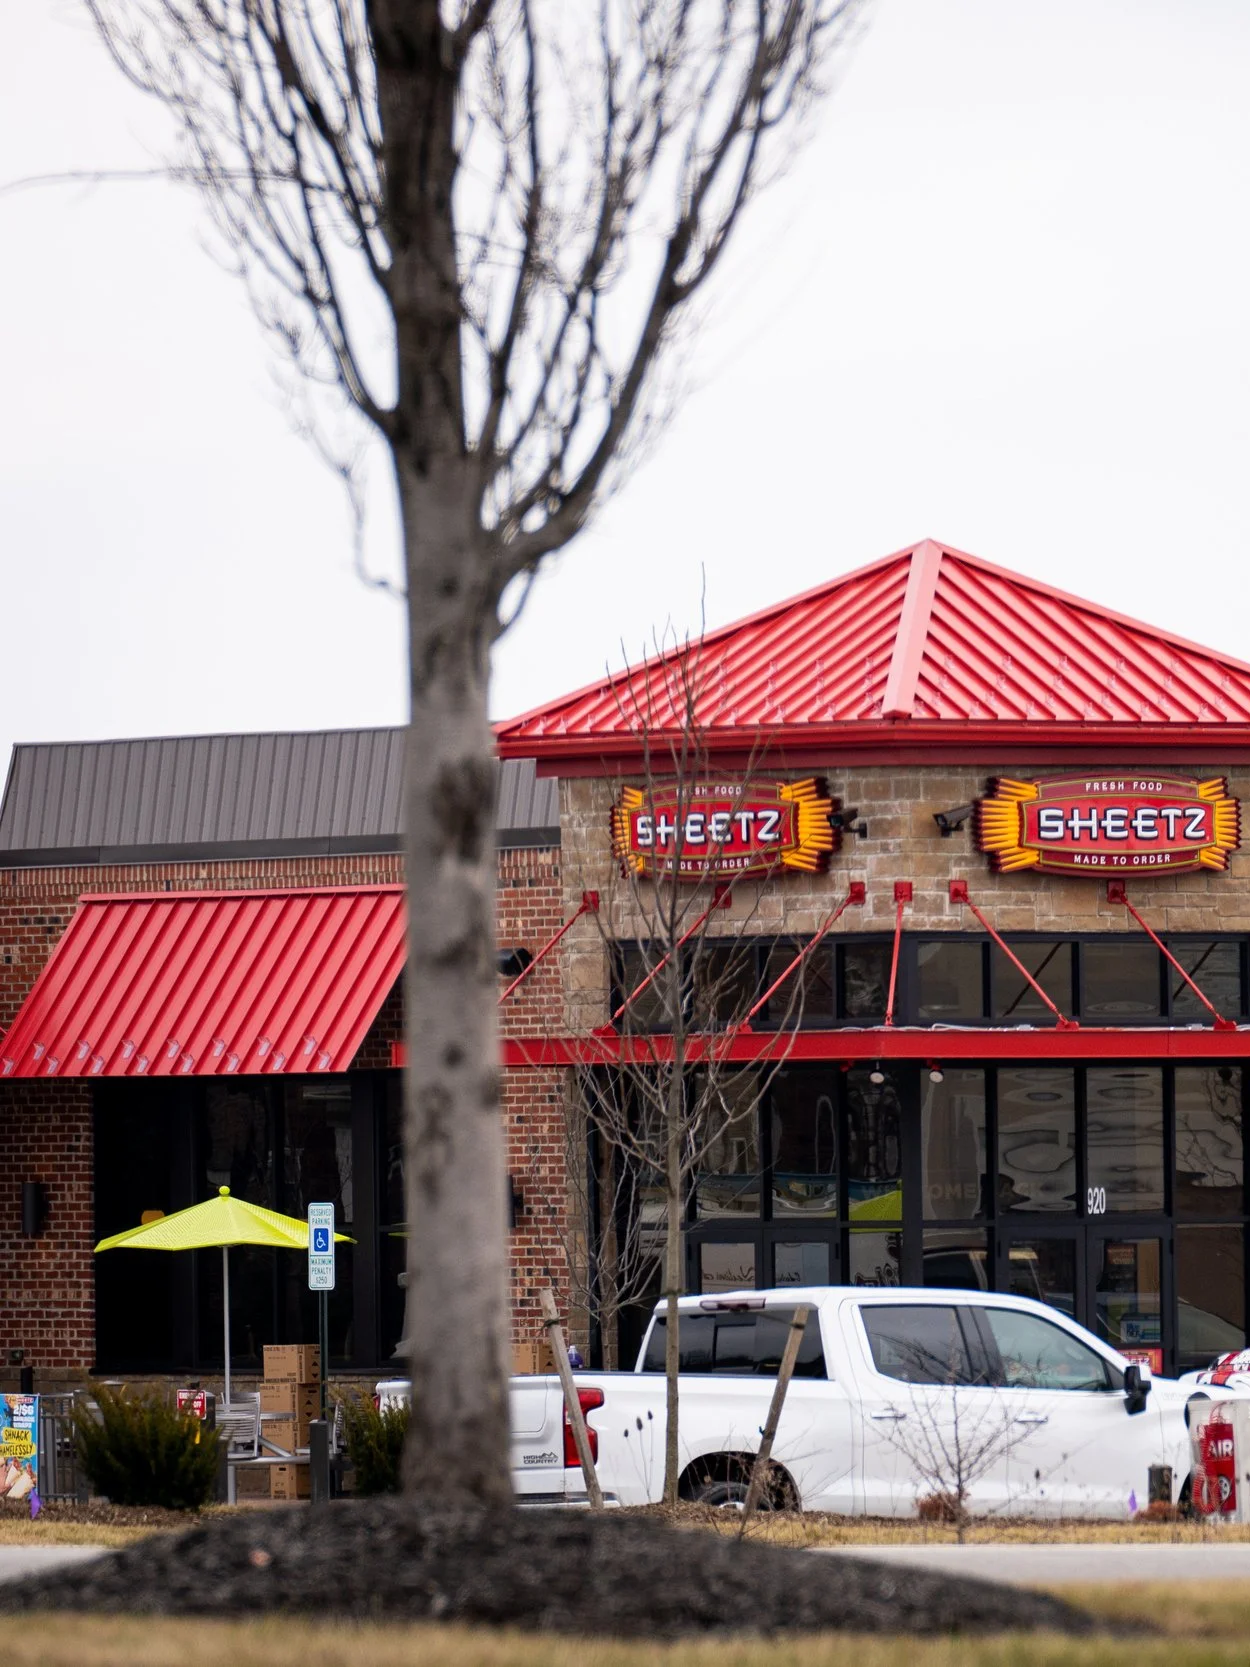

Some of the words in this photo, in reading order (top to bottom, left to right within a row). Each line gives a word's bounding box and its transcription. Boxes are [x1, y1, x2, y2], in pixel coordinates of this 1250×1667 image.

[714, 786, 742, 796] FOOD
[1085, 781, 1125, 792] FRESH
[1133, 781, 1163, 791] FOOD
[637, 810, 780, 845] SHEETZ
[1039, 808, 1206, 839] SHEETZ
[667, 860, 692, 870] MDE
[1073, 855, 1106, 865] MADE
[1113, 855, 1127, 865] TO
[1133, 854, 1171, 864] ORDER
[1087, 1187, 1106, 1215] 920
[1208, 1439, 1233, 1458] AIR
